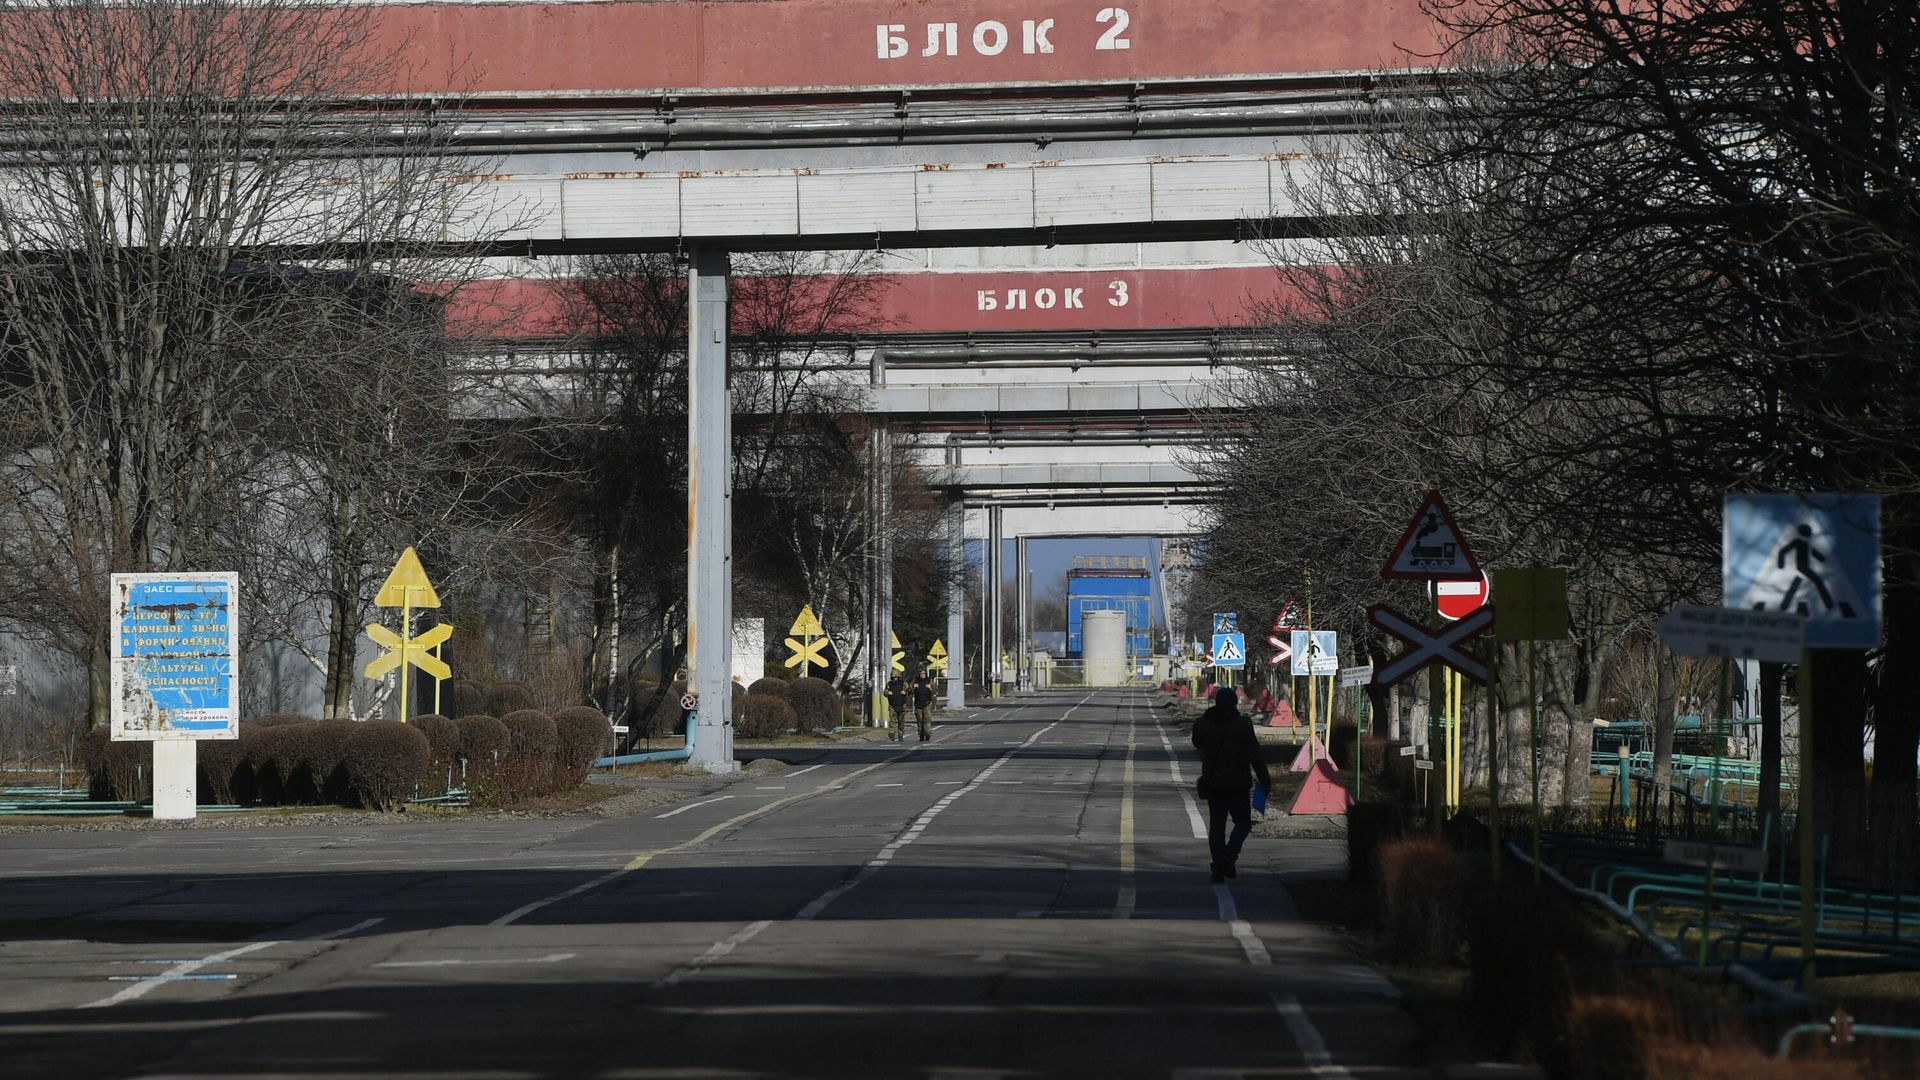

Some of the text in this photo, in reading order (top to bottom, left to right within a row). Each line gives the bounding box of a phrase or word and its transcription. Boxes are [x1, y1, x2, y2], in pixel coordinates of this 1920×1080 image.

[876, 7, 1130, 59] БЛОК 2
[977, 280, 1129, 311] БЛОК 3
[143, 585, 173, 593] ЗАЕС
[133, 611, 191, 620] ПЕРСОАЛ
[137, 637, 225, 646] ФОРМИОВАНИИ
